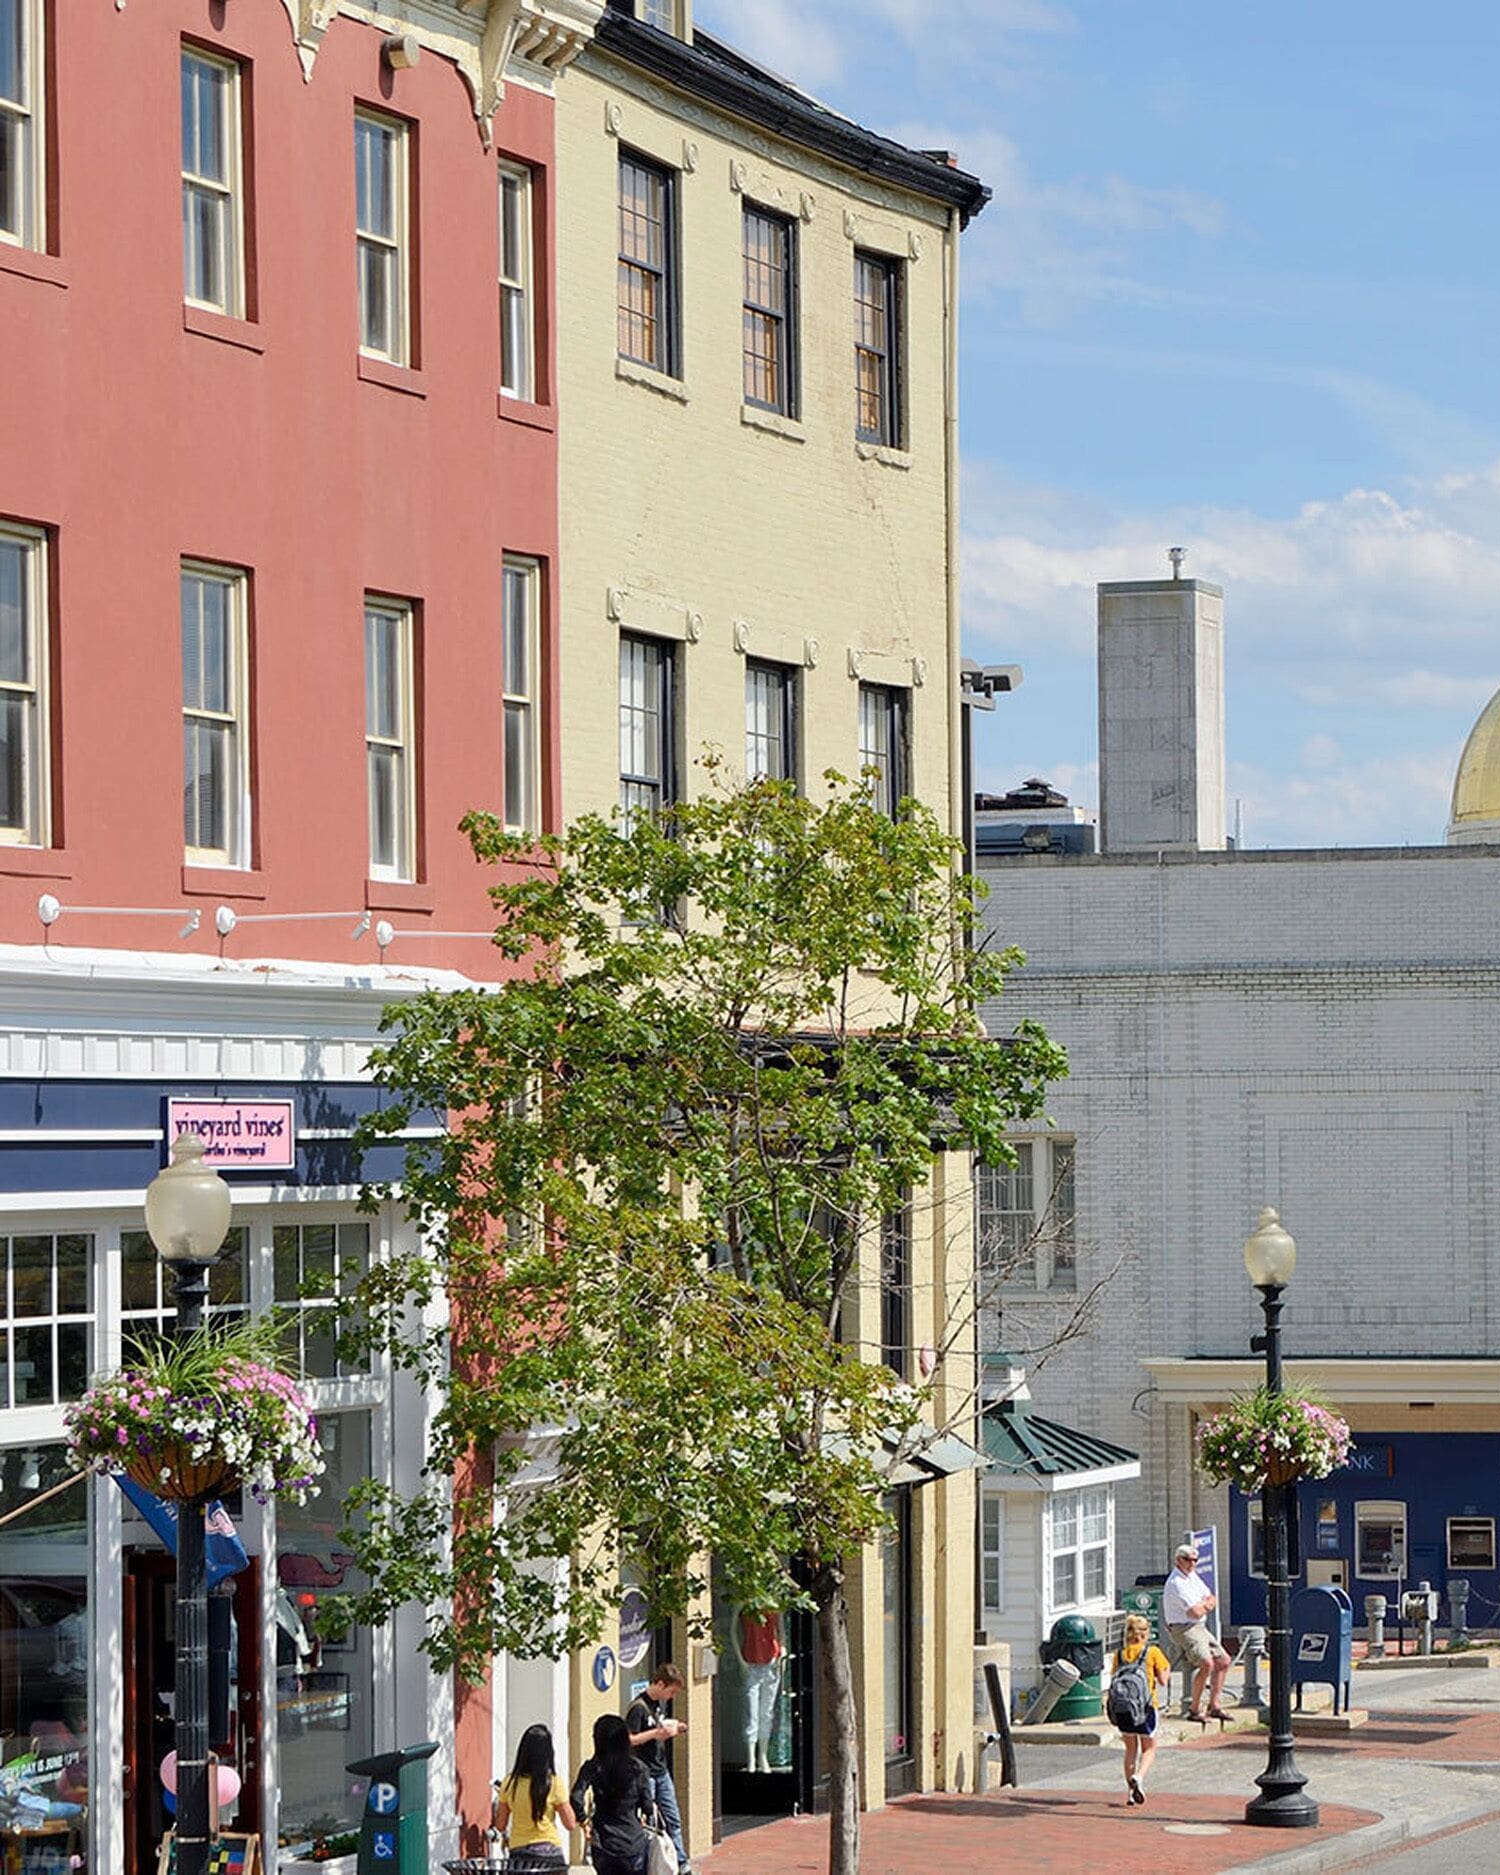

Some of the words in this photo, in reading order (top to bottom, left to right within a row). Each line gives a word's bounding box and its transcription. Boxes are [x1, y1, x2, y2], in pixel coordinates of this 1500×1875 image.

[175, 1109, 242, 1144] vineyard
[245, 1112, 285, 1136] vines
[234, 1143, 266, 1160] vineyard
[377, 1782, 397, 1813] P
